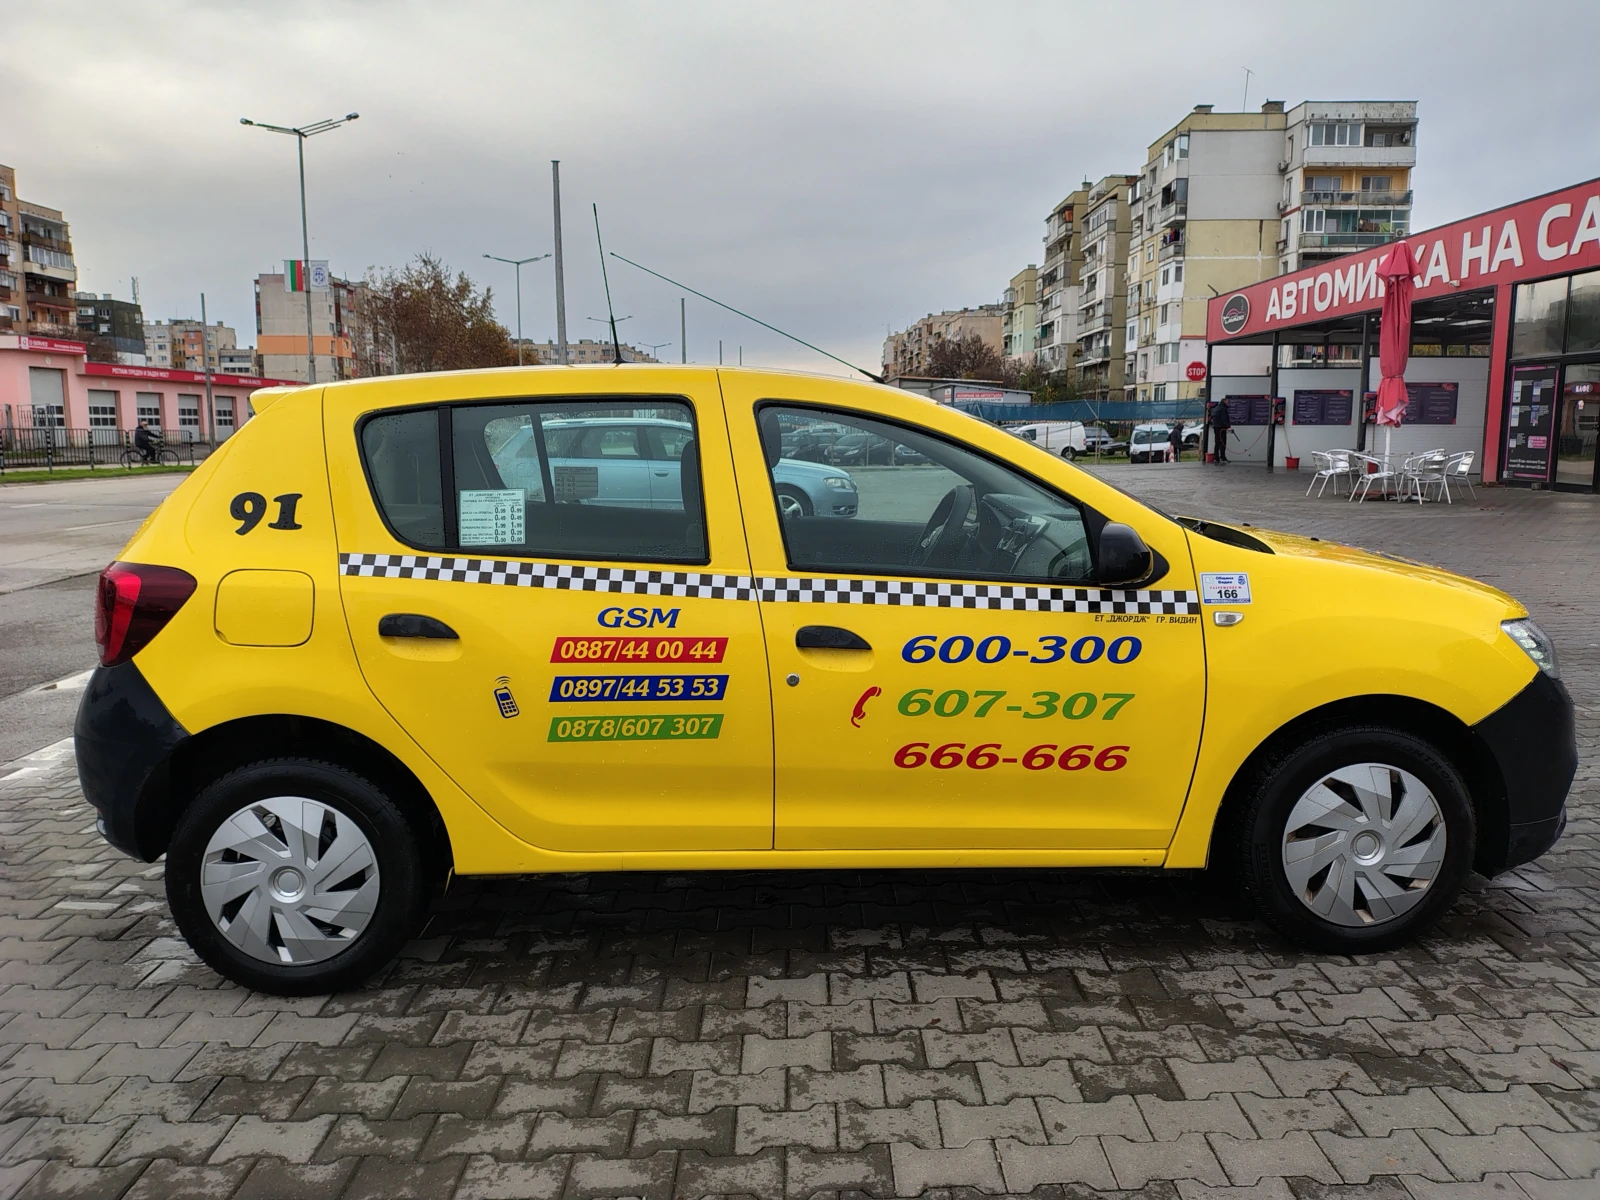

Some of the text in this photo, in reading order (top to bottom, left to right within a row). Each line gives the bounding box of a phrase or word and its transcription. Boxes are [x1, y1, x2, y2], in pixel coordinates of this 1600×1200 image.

[1461, 219, 1524, 279] НА
[1537, 195, 1600, 261] СА
[1188, 367, 1206, 376] STOP
[230, 491, 303, 536] 91
[1217, 589, 1238, 599] 166
[597, 607, 682, 629] GSM
[1094, 614, 1104, 622] ЕТ
[1169, 616, 1197, 624] ВИДИН
[560, 639, 717, 661] 0887/44 00 44
[901, 635, 1142, 665] 600-300
[559, 678, 719, 699] 0897/44 53 53
[897, 688, 1136, 721] 607-307
[557, 717, 714, 739] 0878/607 307
[893, 742, 1131, 772] 666-666
